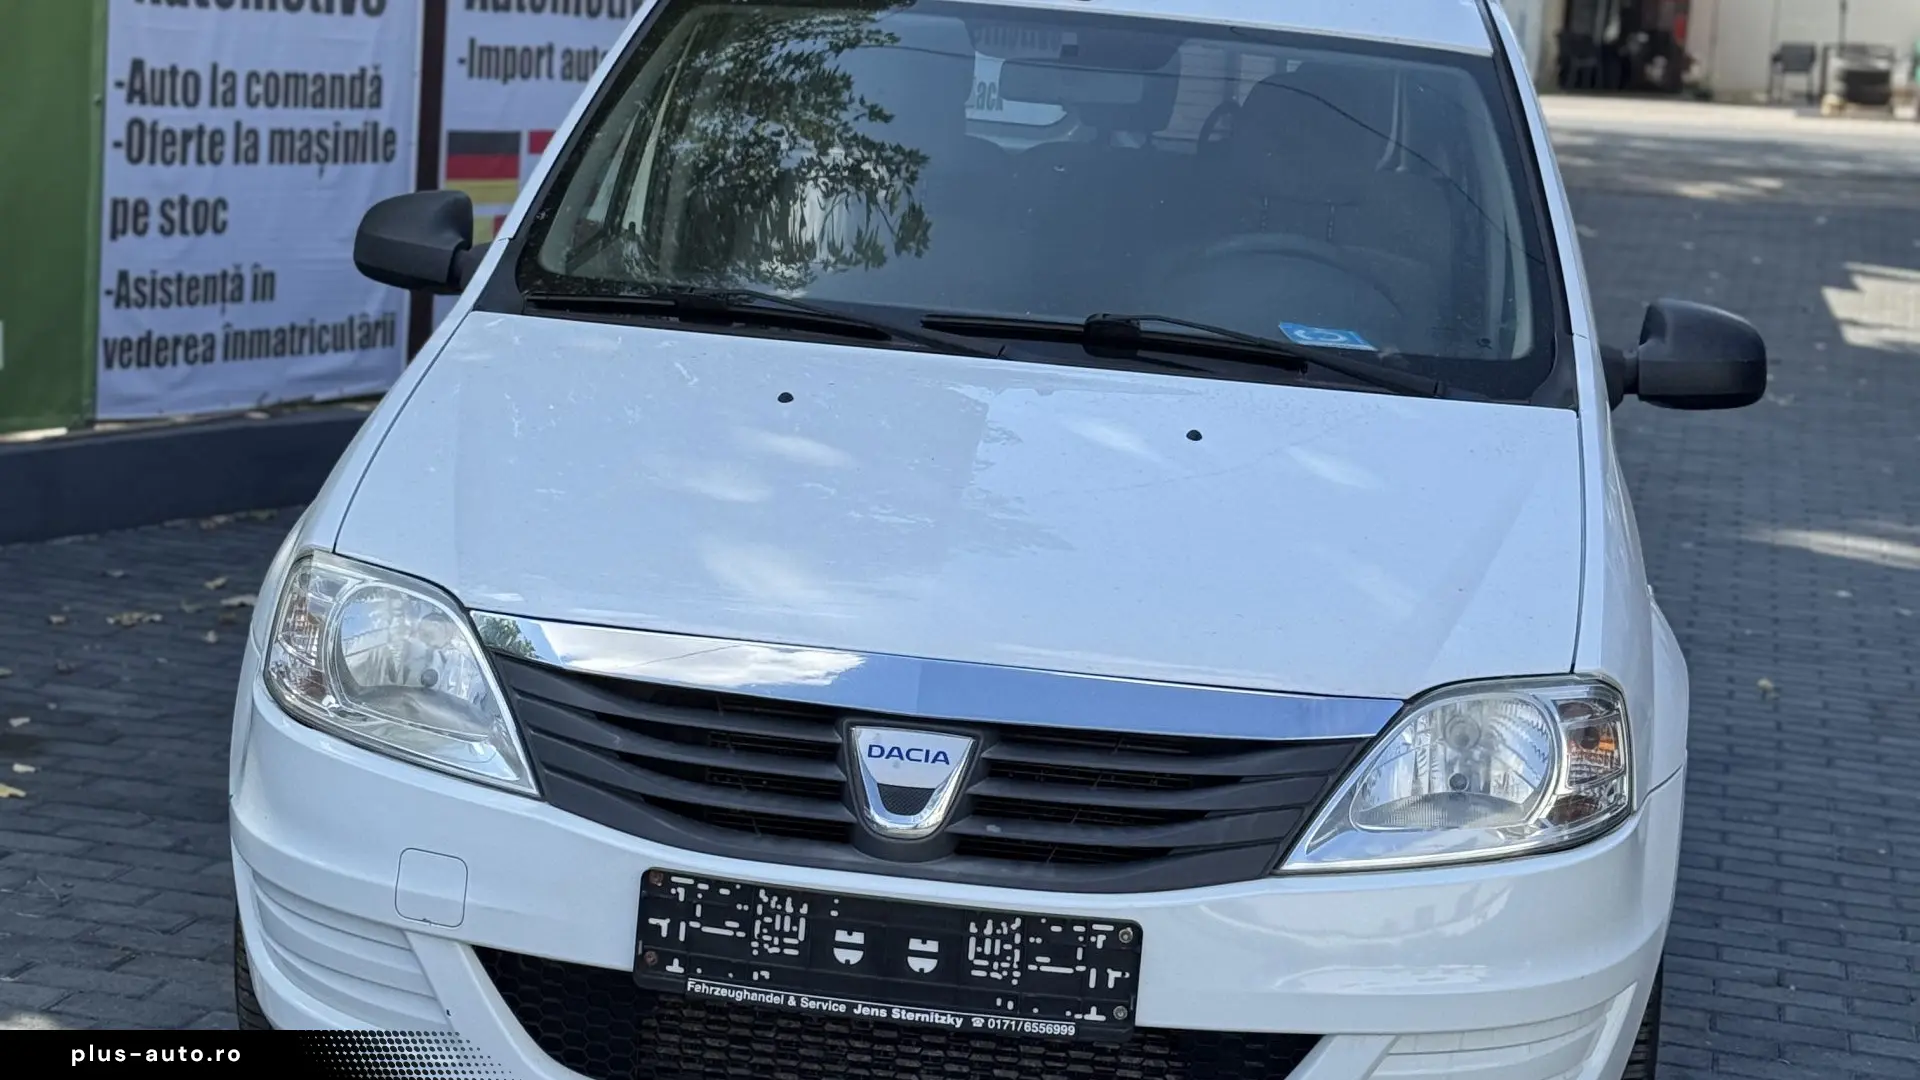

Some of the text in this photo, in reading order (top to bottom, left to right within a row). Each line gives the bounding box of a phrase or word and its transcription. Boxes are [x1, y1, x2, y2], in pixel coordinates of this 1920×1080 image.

[114, 57, 383, 109] -Auto la comandă
[457, 36, 608, 84] -Import aut
[113, 117, 226, 166] -Oferte
[232, 119, 260, 165] la
[110, 194, 228, 241] pe stoc
[251, 261, 276, 303] în
[102, 329, 216, 370] vederea
[867, 744, 950, 765] DACIA
[687, 980, 1075, 1036] Fahrzeughandel & Service Jens Sternitzky 0171/6556999
